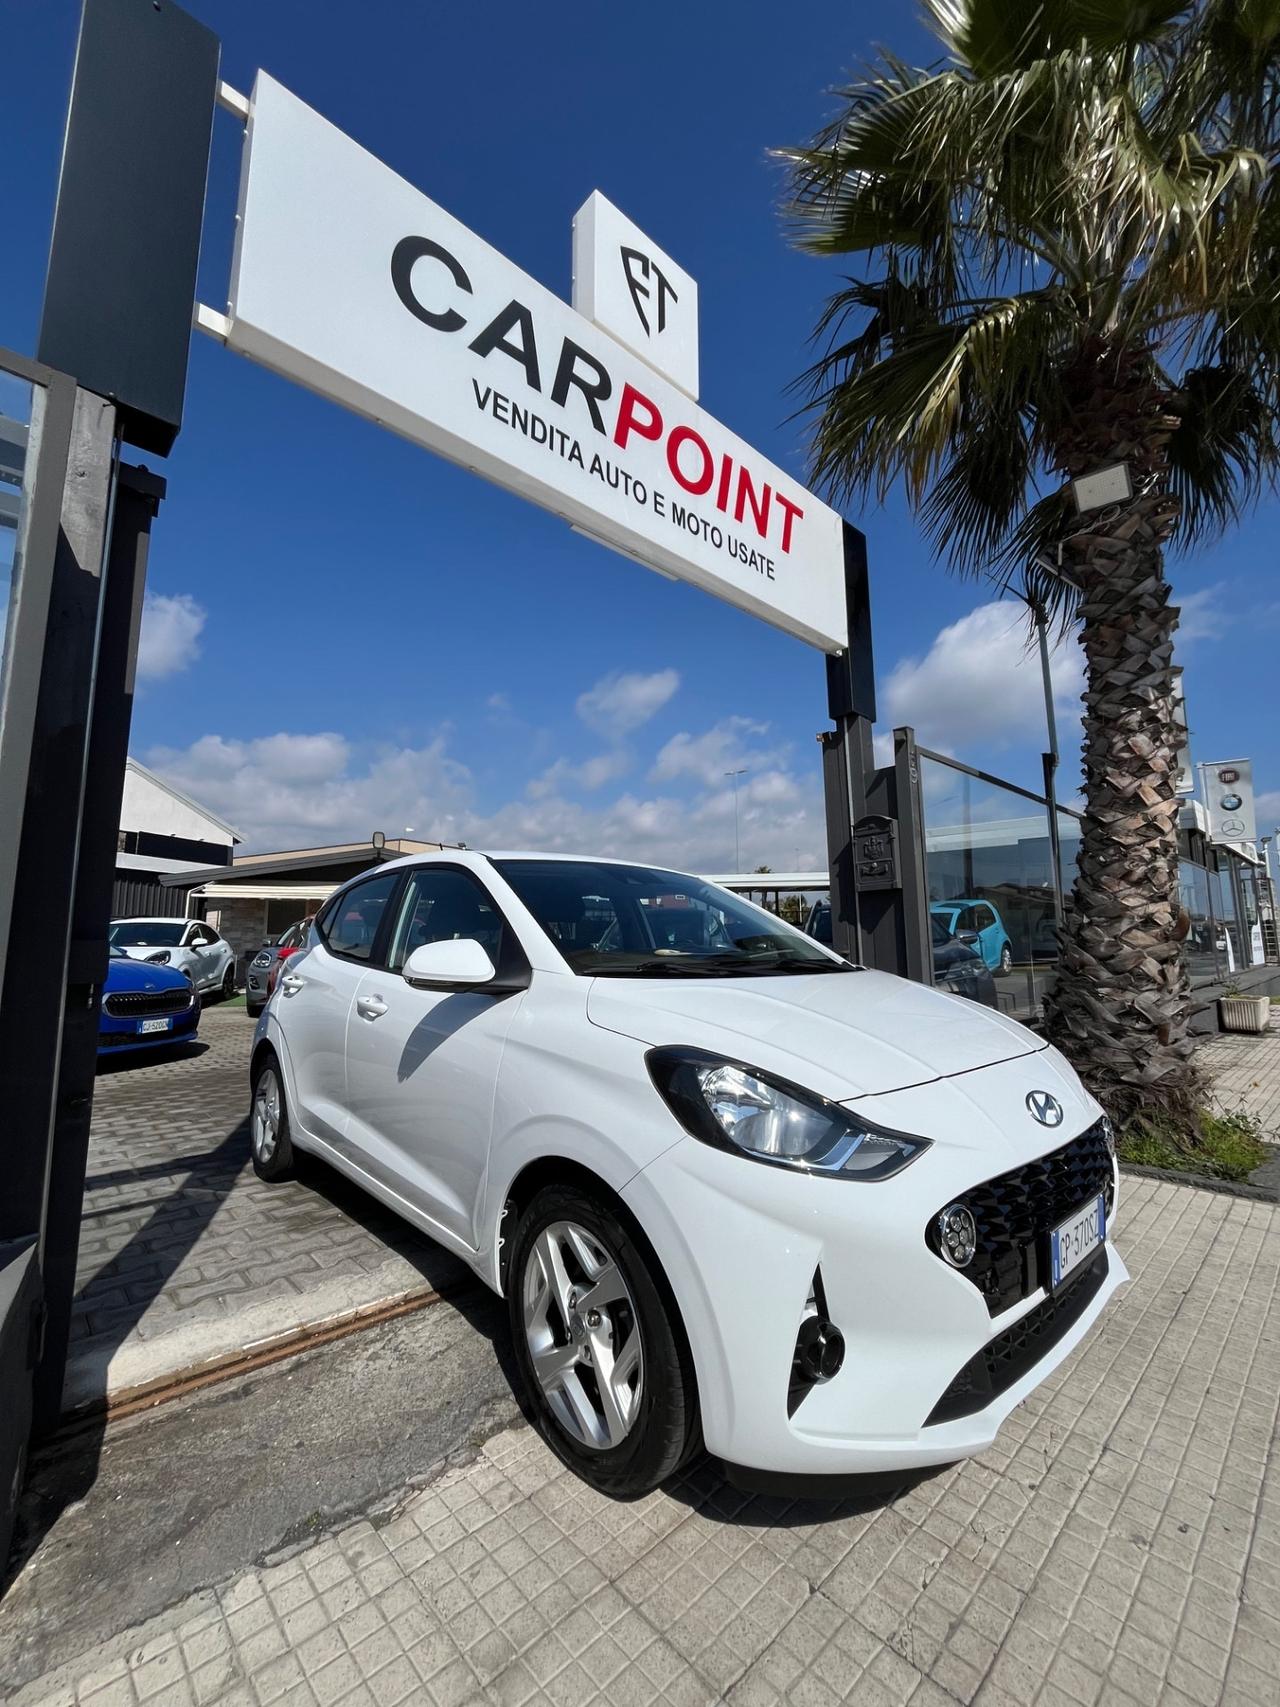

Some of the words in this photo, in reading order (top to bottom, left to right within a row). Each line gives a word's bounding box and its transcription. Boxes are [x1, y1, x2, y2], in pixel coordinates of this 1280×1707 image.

[390, 236, 804, 554] CARPOINT
[473, 378, 584, 466] VENDITA
[590, 454, 648, 507] AUTO
[653, 490, 667, 518] E
[671, 502, 723, 549] MOTO
[728, 538, 776, 581] USATE
